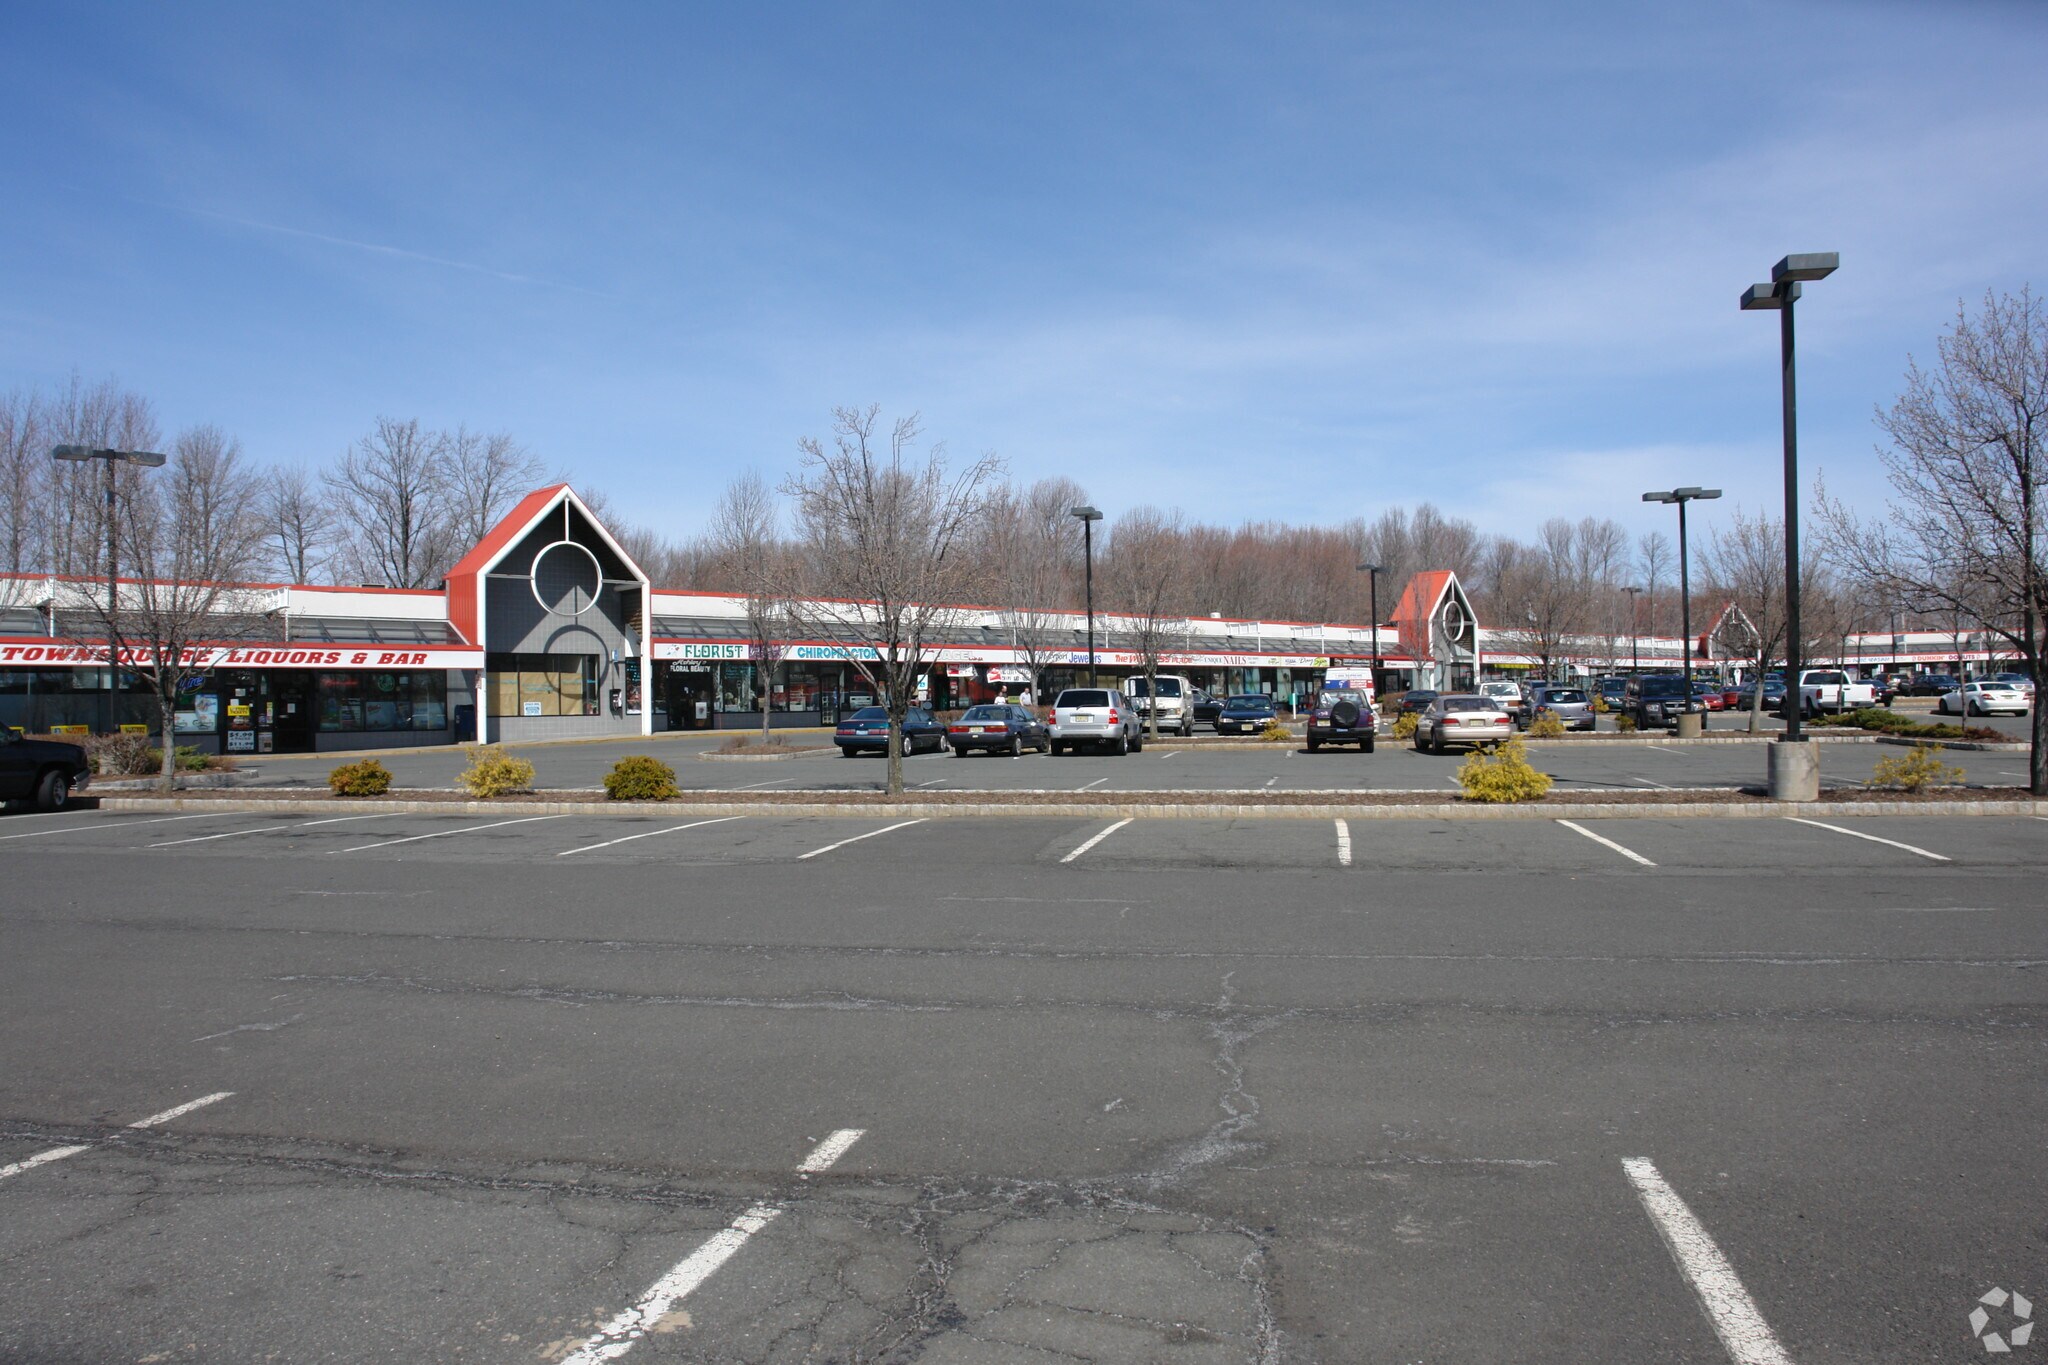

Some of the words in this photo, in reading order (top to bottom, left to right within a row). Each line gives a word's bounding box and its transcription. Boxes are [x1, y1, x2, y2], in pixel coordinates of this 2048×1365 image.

[226, 650, 341, 664] LIQUORS
[350, 653, 368, 664] &
[377, 653, 427, 665] BAR
[685, 645, 744, 658] FLORIST
[797, 647, 878, 659] CHIROPRACTOR
[1068, 652, 1102, 663] Jewers
[1223, 656, 1246, 665] NAILS
